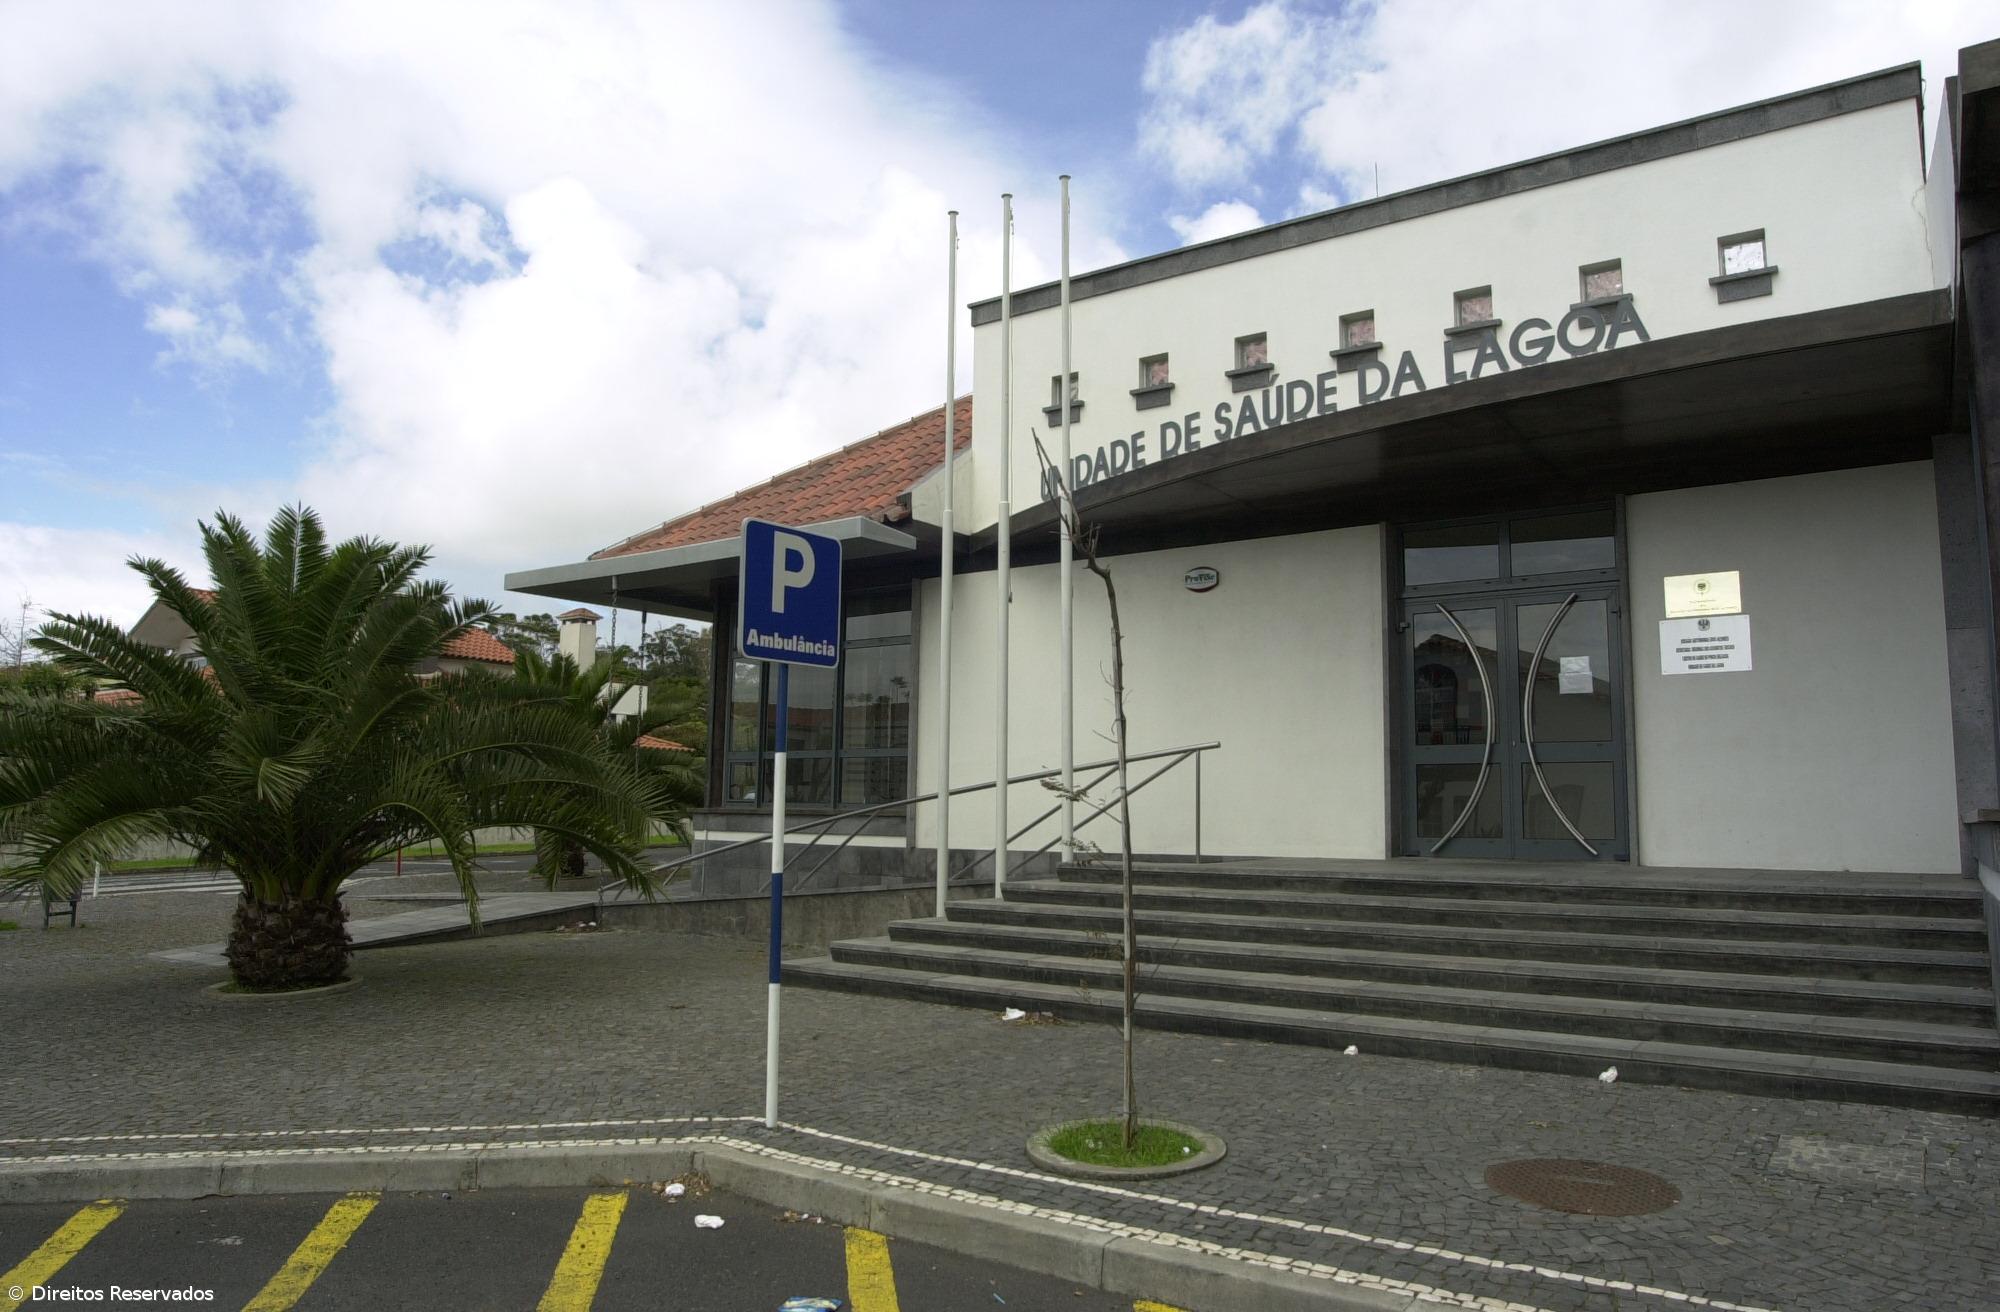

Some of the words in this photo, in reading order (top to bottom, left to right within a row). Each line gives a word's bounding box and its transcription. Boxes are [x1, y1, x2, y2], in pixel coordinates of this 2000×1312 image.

[1160, 412, 1201, 460] DE
[1214, 371, 1338, 442] SAÚDE
[1357, 350, 1426, 405] DA
[1443, 299, 1650, 385] LAGOA
[771, 530, 815, 613] P
[746, 628, 835, 657] Ambulância
